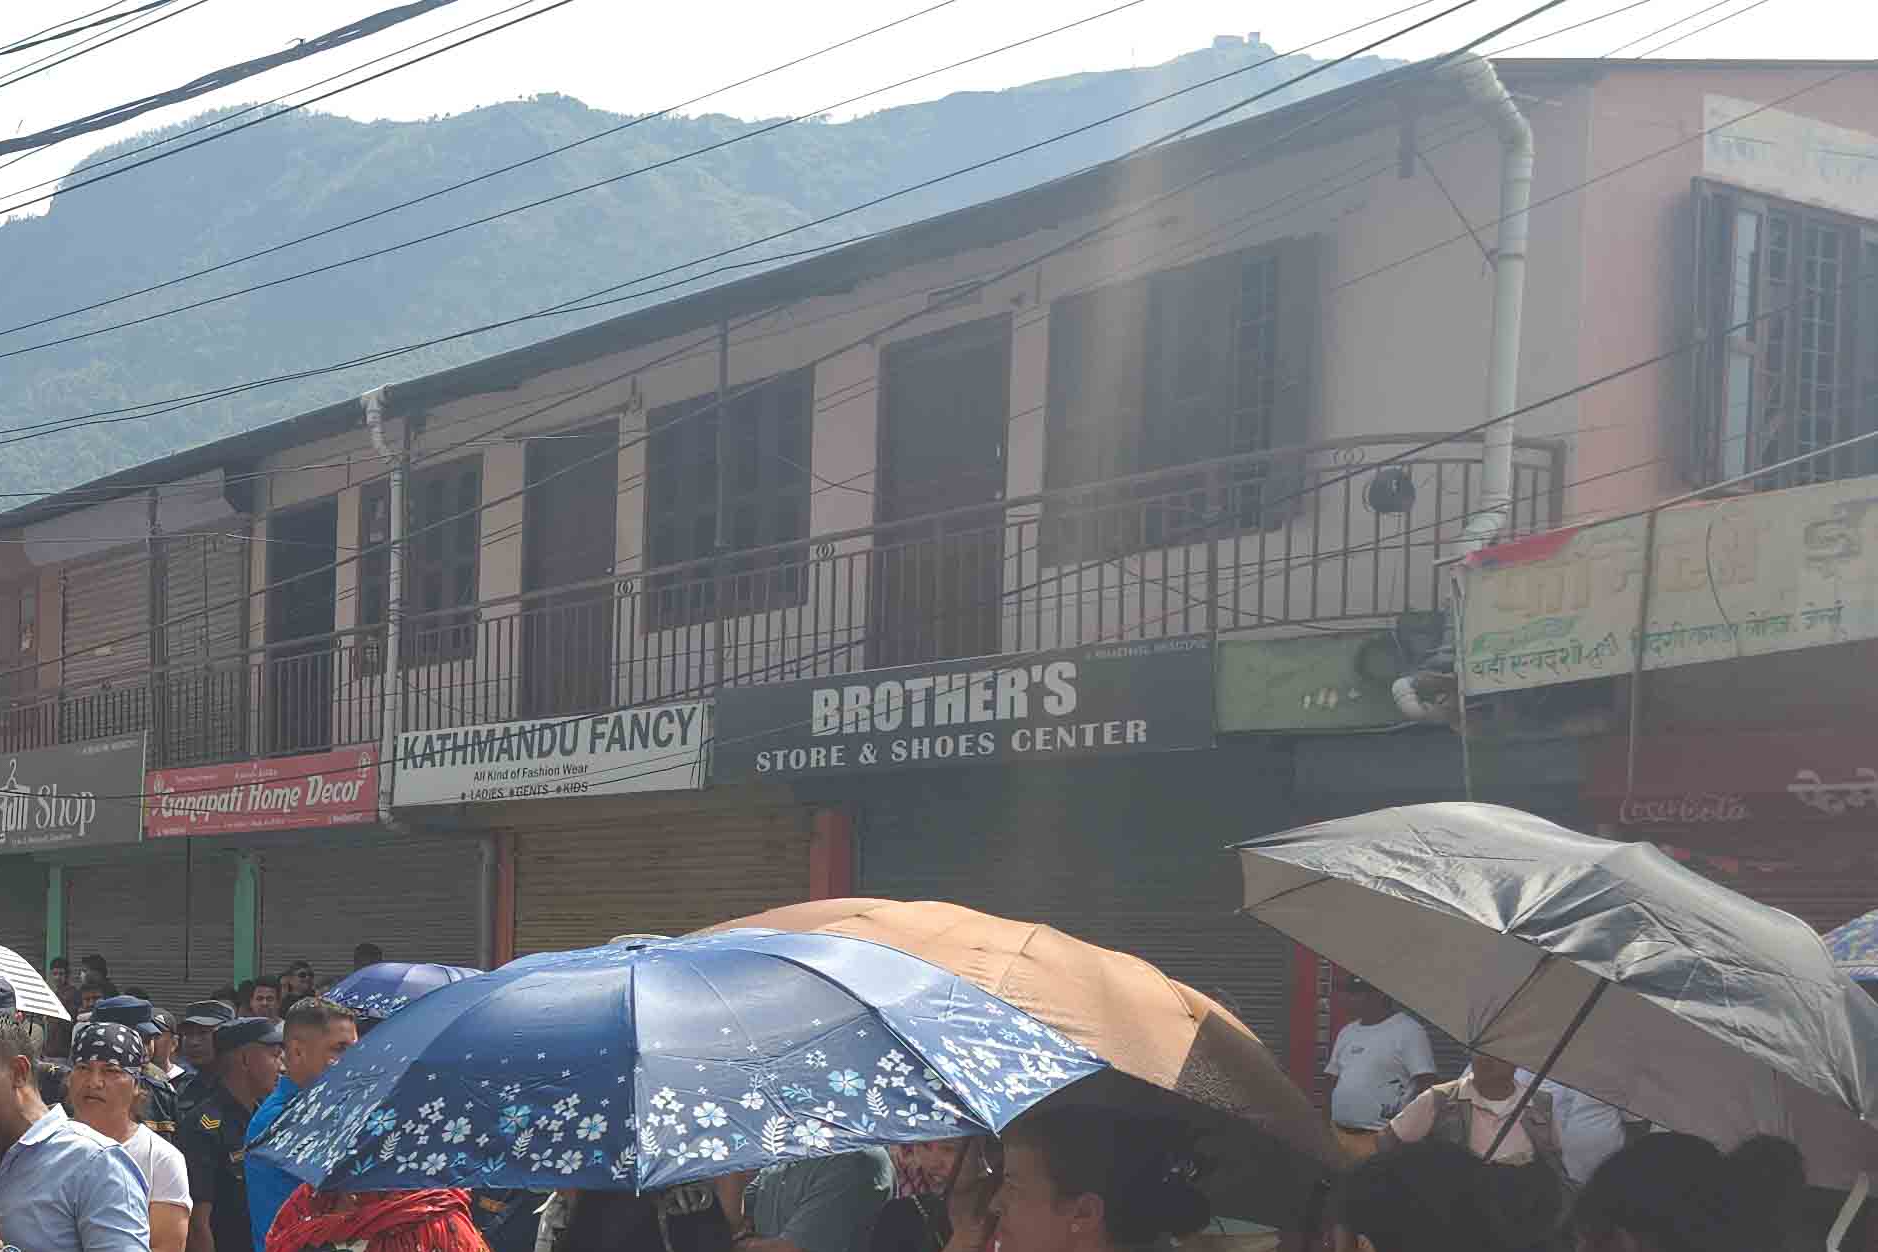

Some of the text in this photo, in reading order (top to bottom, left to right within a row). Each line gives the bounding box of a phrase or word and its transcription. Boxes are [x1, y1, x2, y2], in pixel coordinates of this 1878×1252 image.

[811, 661, 1078, 737] BROTHER'S
[402, 706, 698, 770] KATHMANDU FANCY
[756, 719, 1148, 773] STORE & SHOES CENTER
[247, 783, 302, 813] Home
[306, 775, 365, 806] Decor
[487, 769, 508, 781] Kind
[510, 767, 521, 779] of
[522, 765, 560, 778] Fashion
[562, 763, 589, 776] Wear
[563, 781, 589, 794] KIDS
[35, 783, 97, 837] Shop
